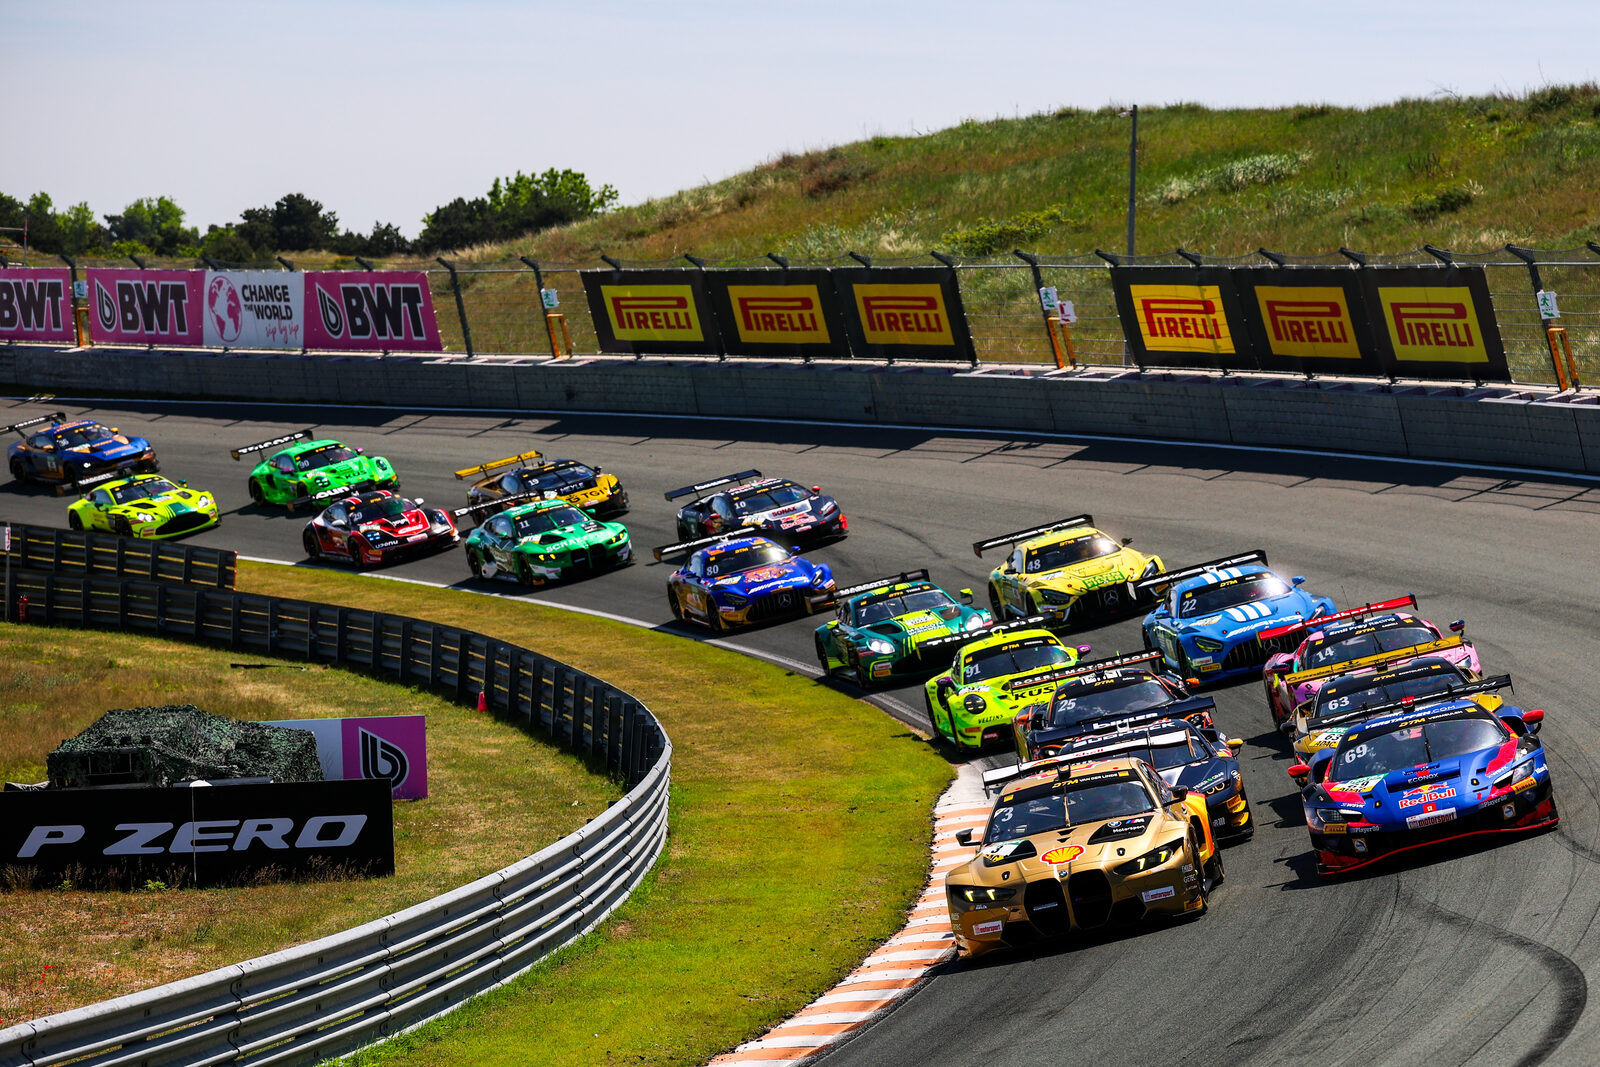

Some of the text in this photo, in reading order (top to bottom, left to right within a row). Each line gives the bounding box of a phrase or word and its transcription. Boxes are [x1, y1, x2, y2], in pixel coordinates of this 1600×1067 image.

[242, 284, 291, 303] CHANGE
[0, 279, 64, 331] BWT
[115, 280, 189, 336] BWT
[244, 304, 293, 320] THE WORLD
[339, 284, 427, 341] BWT
[612, 296, 692, 330] PIRELLI
[738, 297, 818, 332] PIRELLI
[862, 296, 944, 333] PIRELLI
[1141, 299, 1222, 339] PIRELLI
[1266, 300, 1348, 343] PIRELLI
[279, 316, 288, 344] by
[1391, 302, 1475, 348] PIRELLI
[528, 478, 540, 486] 19
[734, 501, 747, 510] 10
[771, 505, 798, 517] SONAX
[519, 520, 530, 529] 11
[706, 564, 719, 577] 80
[1027, 559, 1041, 572] 48
[860, 608, 867, 617] 7
[1181, 599, 1197, 613] 22
[1355, 627, 1376, 635] DTM
[1002, 642, 1020, 651] DTM
[1315, 646, 1336, 663] 14
[1065, 650, 1158, 675] MOTORSPORT
[965, 665, 981, 678] 91
[1372, 673, 1396, 682] DTM
[1093, 679, 1115, 687] DTM
[1014, 685, 1055, 701] KÜS
[1057, 699, 1077, 712] 25
[1327, 695, 1350, 711] 63
[1365, 704, 1456, 730] VERSTAPPEN.COM
[1398, 717, 1426, 728] DTM
[1324, 733, 1342, 742] 63
[1344, 744, 1368, 764] 69
[1051, 779, 1079, 789] DTM
[1407, 773, 1439, 784] ECONOX
[1399, 787, 1457, 809] Red Bull
[1001, 806, 1014, 822] 3
[1418, 812, 1456, 827] motorsport
[16, 814, 368, 858] P ZERO
[1112, 825, 1146, 833] Motorsport
